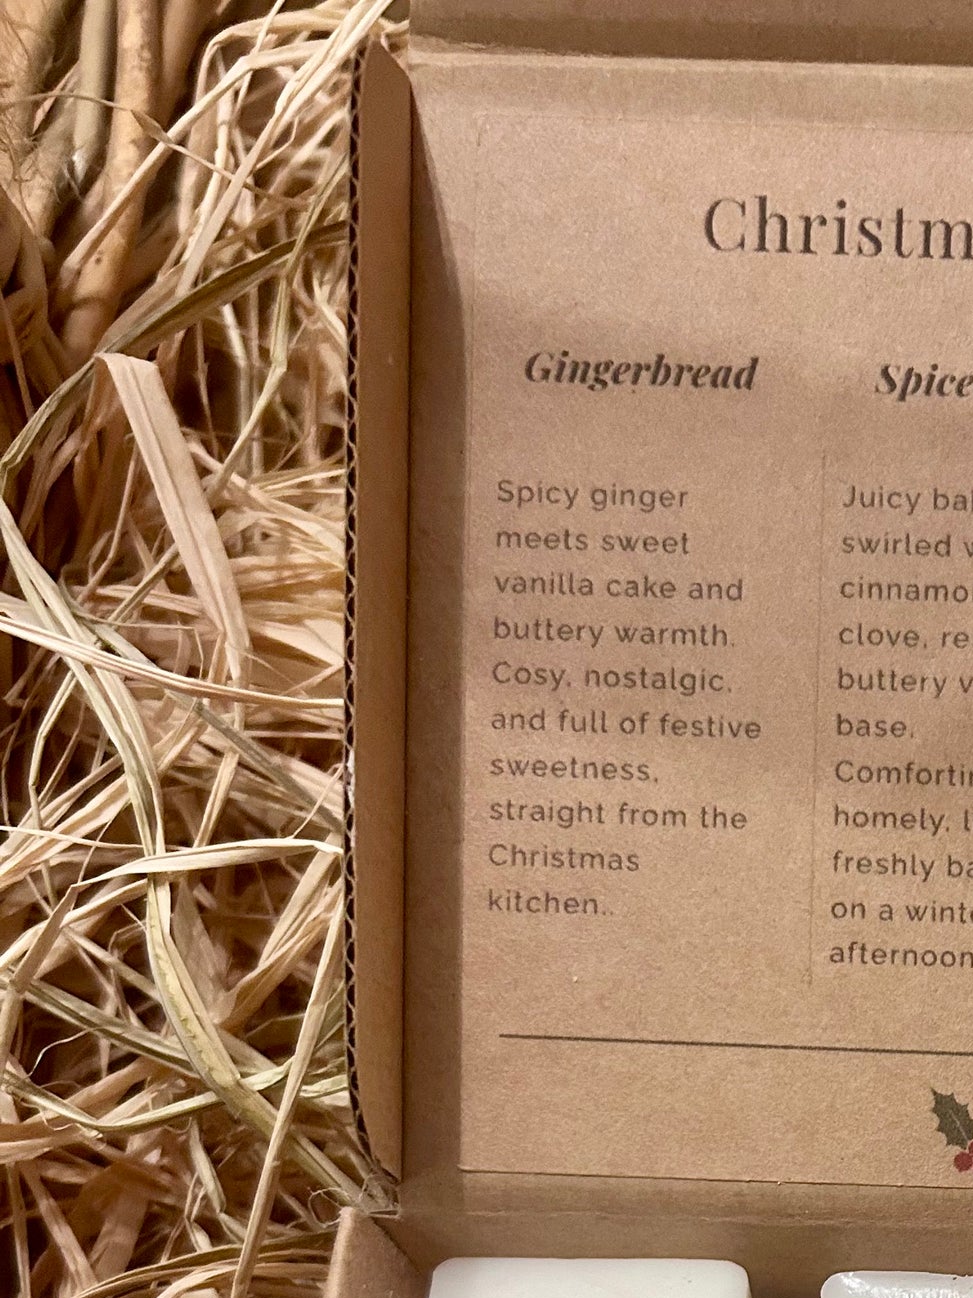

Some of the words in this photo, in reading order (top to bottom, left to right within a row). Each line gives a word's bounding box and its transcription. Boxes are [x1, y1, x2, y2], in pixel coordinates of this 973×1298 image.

[524, 350, 760, 391] Gingerbread
[497, 480, 578, 510] Spicy
[590, 484, 688, 513] ginger
[843, 485, 921, 516] Juicy
[497, 529, 588, 551] meets
[602, 533, 689, 555] sweet
[842, 533, 951, 557] swirled
[495, 572, 593, 596] vanilla
[606, 575, 676, 598] cake
[688, 578, 743, 602] and
[494, 617, 603, 648] buttery
[838, 623, 927, 650] clove,
[837, 667, 946, 699] buttery
[491, 709, 545, 731] and
[558, 709, 608, 734] full
[619, 712, 649, 735] of
[659, 713, 761, 740] festive
[490, 800, 604, 829] straight
[619, 802, 686, 828] from
[700, 806, 747, 829] the
[489, 844, 639, 872] Christmas
[833, 850, 934, 883] freshly
[830, 901, 866, 920] on
[878, 903, 894, 921] a
